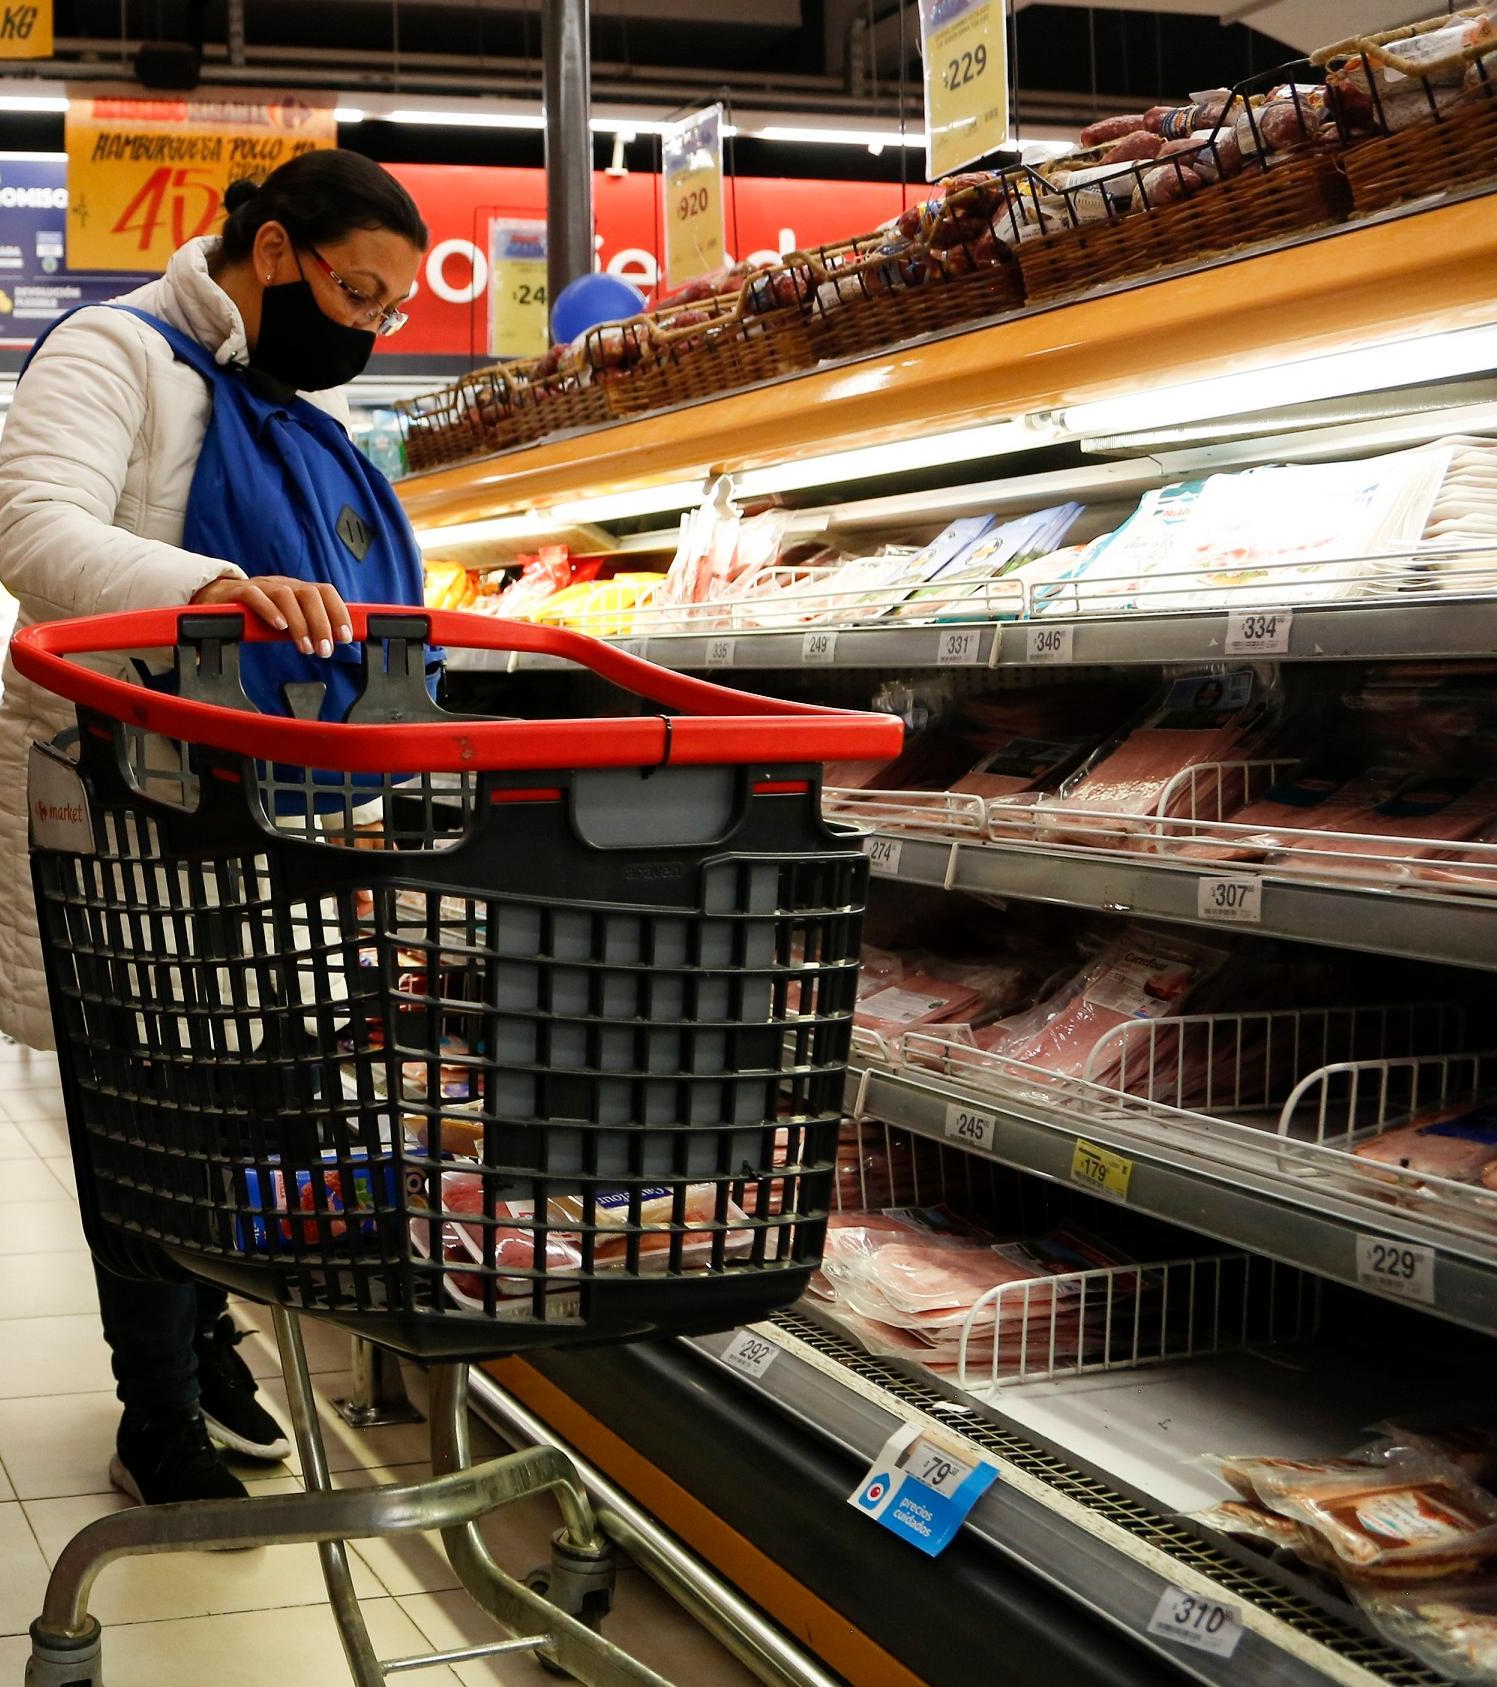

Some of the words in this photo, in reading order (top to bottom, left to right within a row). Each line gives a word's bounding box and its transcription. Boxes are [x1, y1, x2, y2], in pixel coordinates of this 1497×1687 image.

[48, 803, 83, 825] market
[899, 1497, 933, 1522] precios
[892, 1508, 934, 1538] cuidados
